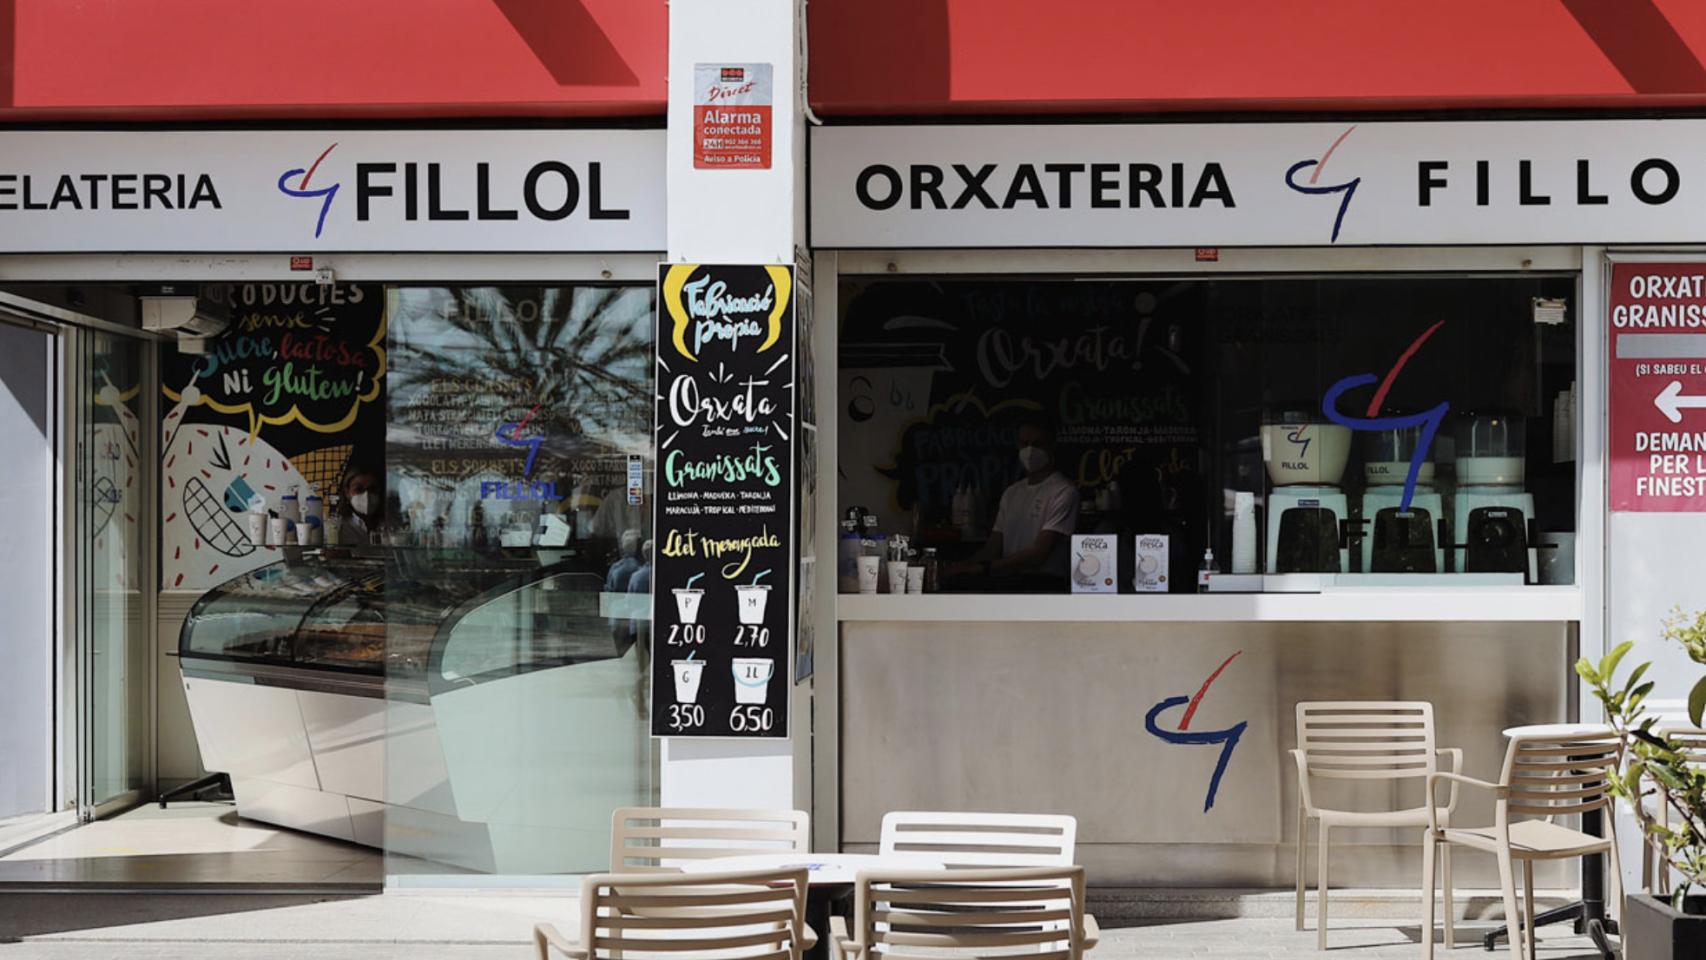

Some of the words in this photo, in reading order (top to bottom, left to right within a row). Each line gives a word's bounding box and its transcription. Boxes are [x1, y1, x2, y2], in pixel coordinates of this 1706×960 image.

[704, 110, 762, 124] Alarma
[704, 125, 762, 135] conectada
[704, 154, 726, 163] Aviso
[356, 161, 631, 221] FILLOL
[855, 163, 1237, 211] ORXATERIA
[1630, 275, 1706, 299] ORXAT
[1635, 363, 1650, 377] (SI
[1653, 363, 1687, 375] SABEU
[1690, 364, 1702, 375] EL
[222, 370, 253, 395] Ni
[669, 374, 777, 426] Orxata
[665, 441, 780, 487] Granissats
[1281, 461, 1310, 470] FILLOL
[1650, 454, 1690, 474] PER
[481, 480, 564, 500] FILLOL
[1636, 476, 1706, 497] FINEST
[662, 528, 699, 557] Llet
[1080, 539, 1108, 550] fresca
[1139, 540, 1164, 550] fresca
[684, 597, 692, 608] P
[748, 598, 756, 607] M
[667, 624, 706, 647] 2,00
[733, 625, 770, 648] 2,70
[682, 670, 690, 684] G
[669, 704, 705, 732] 3,50
